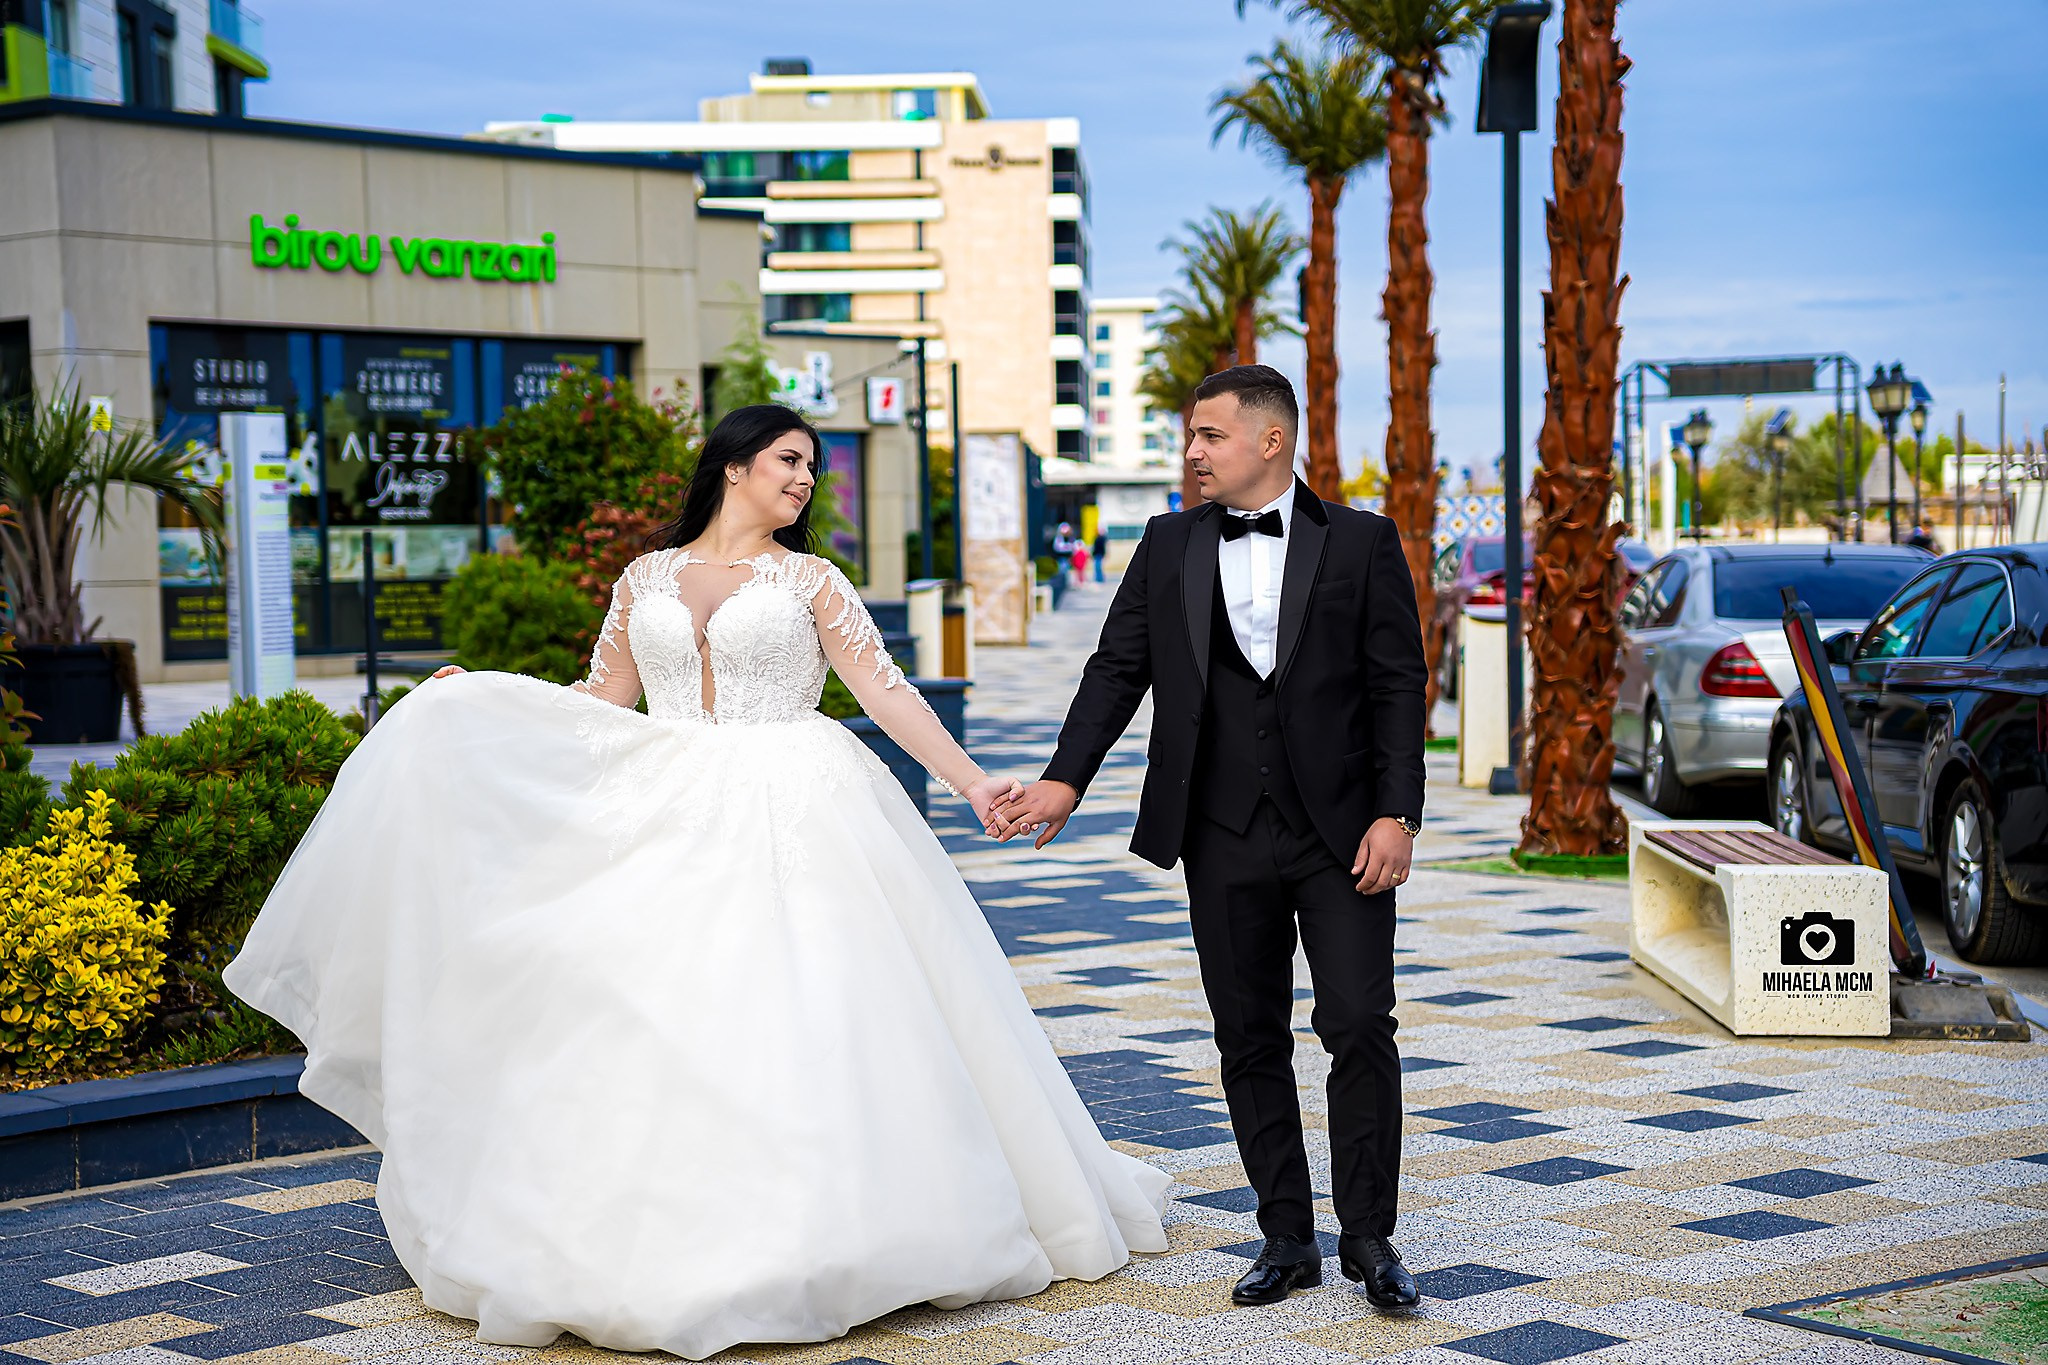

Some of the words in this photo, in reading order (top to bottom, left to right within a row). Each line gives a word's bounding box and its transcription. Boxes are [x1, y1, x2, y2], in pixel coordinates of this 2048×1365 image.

[250, 213, 382, 274] birou
[389, 231, 557, 283] vanzari
[193, 358, 268, 384] STUDIO
